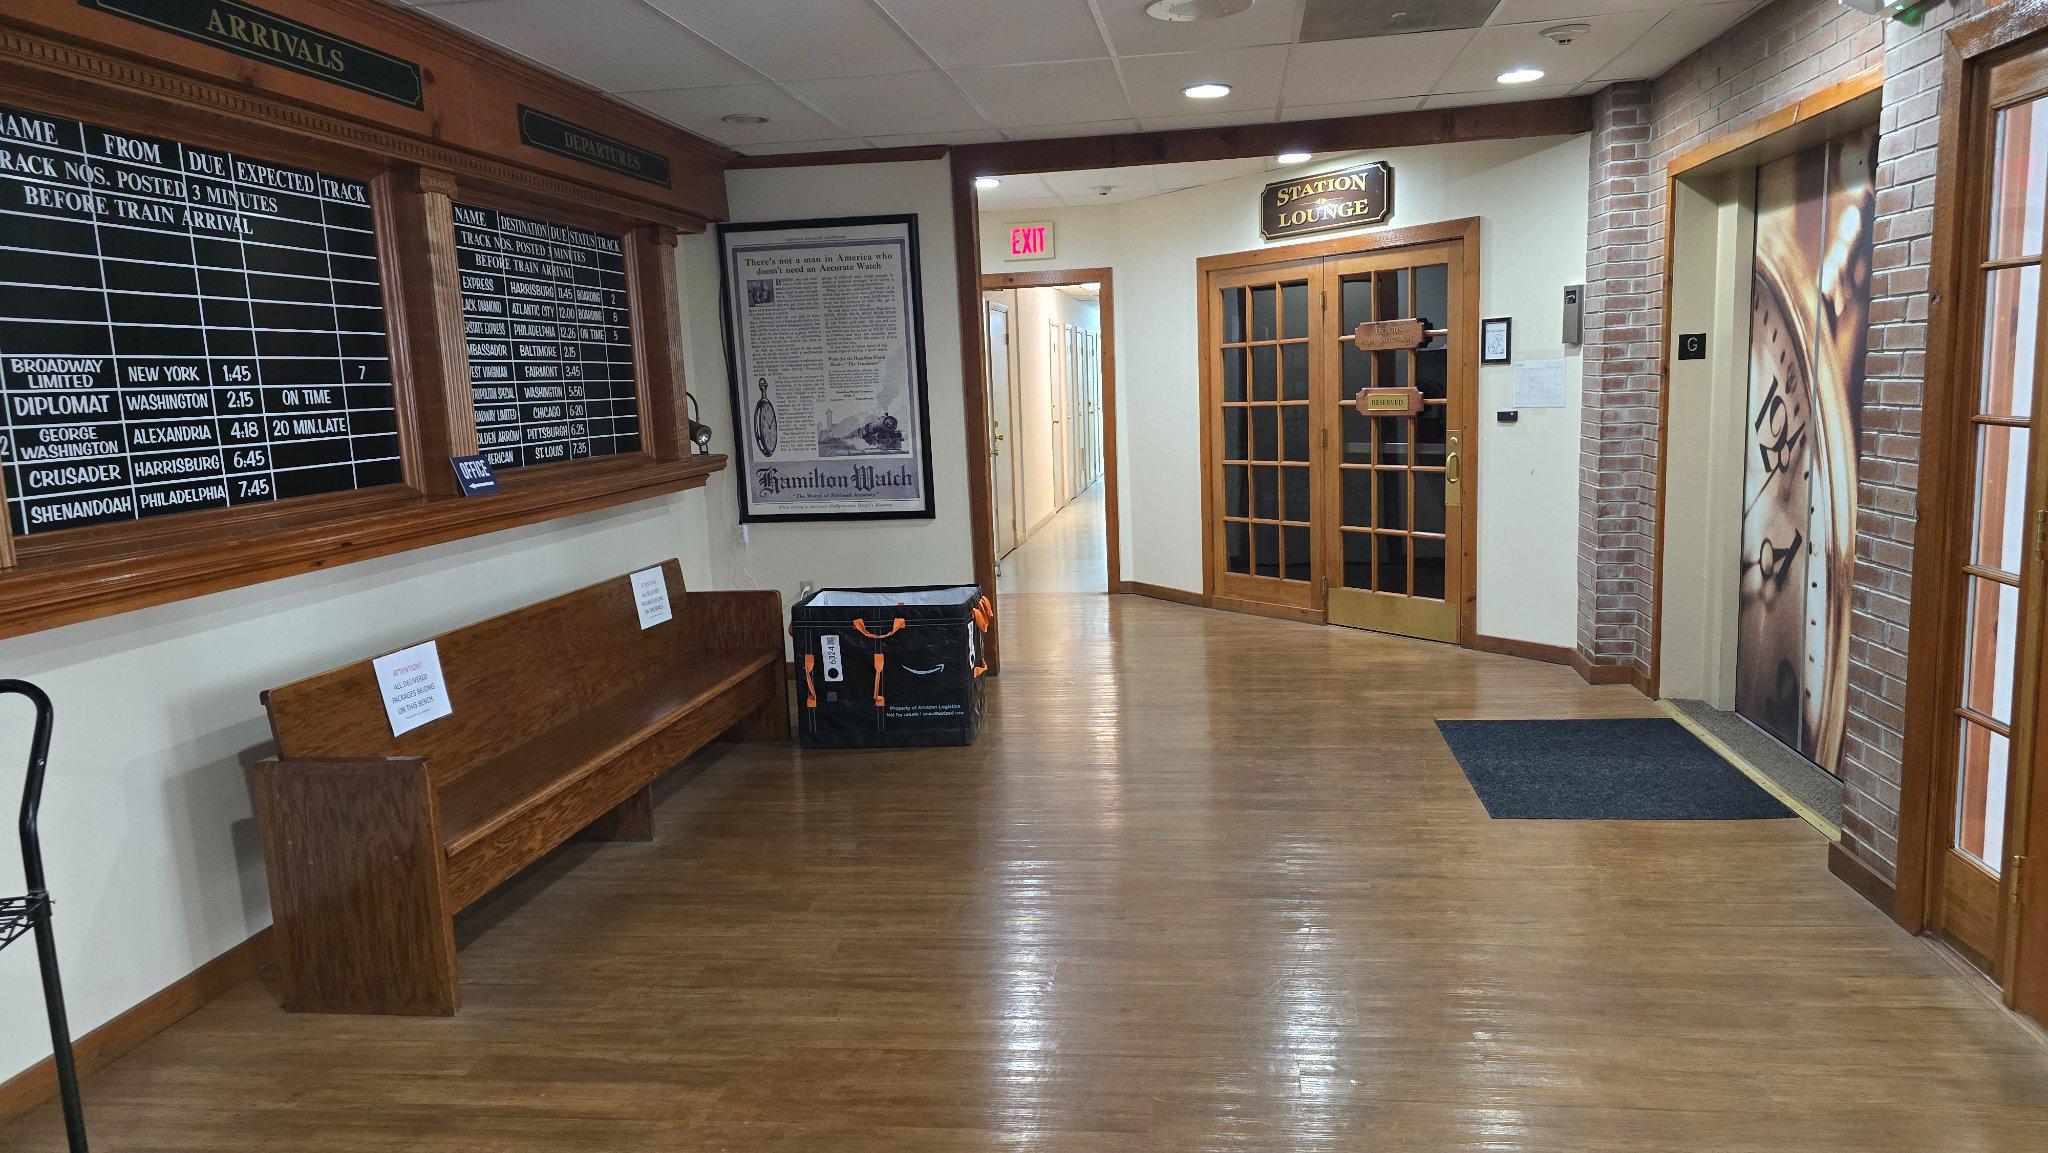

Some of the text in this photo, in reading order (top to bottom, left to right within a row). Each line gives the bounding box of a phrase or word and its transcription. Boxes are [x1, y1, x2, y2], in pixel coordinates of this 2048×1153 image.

[206, 8, 344, 72] ARRIVALS
[564, 131, 641, 170] DEPARTURES
[103, 133, 162, 164] FROM
[189, 151, 225, 176] DUE
[237, 161, 314, 193] EXPECTED
[322, 179, 366, 202] TRACK
[65, 161, 110, 186] NOS.
[117, 170, 187, 198] POSTED
[192, 184, 200, 200] 3
[207, 186, 278, 213] MINUTES
[1276, 172, 1368, 207] STATION
[24, 185, 253, 235] BEFORE TRAIN ARRIVAL
[1278, 199, 1369, 228] LOUNGE
[454, 206, 620, 252] NAME DESTINATION DUE STATUS TRACK
[461, 231, 491, 248] TRACK
[494, 237, 513, 251] NOS.
[516, 240, 546, 257] POSTED
[553, 247, 585, 262] MINUTES
[1011, 226, 1046, 255] EXIT
[475, 254, 573, 278] BEFORE TRAIN ARRIVAL
[745, 258, 776, 267] There's
[825, 254, 832, 262] in
[837, 252, 872, 262] America
[876, 252, 892, 260] who
[756, 267, 782, 275] doesn't
[786, 265, 803, 274] need
[820, 264, 854, 272] Accurate
[856, 262, 881, 270] Watch
[462, 275, 494, 292] EXPRESS
[510, 281, 555, 298] HARRISBURG
[611, 294, 615, 304] 2
[512, 302, 555, 317] ATLANTIC CITY
[613, 312, 617, 322] 8
[514, 324, 556, 338] PHILADELPHIA
[614, 331, 618, 340] 5
[520, 345, 557, 357] BALTIMORE
[1687, 337, 1698, 352] G
[11, 359, 103, 374] BROADWAY
[128, 365, 199, 382] NEW YORK
[223, 365, 251, 381] 1:45
[358, 366, 366, 380] 7
[525, 366, 558, 378] FAIRMONT
[28, 374, 94, 389] LIMITED
[14, 395, 110, 417] DIPLOMAT
[126, 393, 208, 411] WASHINGTON
[227, 391, 254, 408] 2:15
[282, 390, 332, 405] ON TIME
[533, 406, 560, 418] CHICAGO
[39, 426, 98, 441] GEORGE
[133, 425, 212, 444] ALEXANDRIA
[231, 421, 259, 438] 4:18
[273, 420, 289, 436] 20
[498, 430, 519, 442] ARROW
[527, 425, 568, 440] PITTSBURGH
[20, 440, 118, 461] WASHINGTON
[135, 457, 220, 477] HARRISBURG
[234, 450, 265, 469] 6:45
[29, 465, 121, 489] CRUSADER
[459, 460, 490, 480] OFFICE
[238, 478, 269, 498] 7:45
[756, 464, 912, 498] Hamilton Watch
[141, 485, 225, 509] PHILADELPHIA
[31, 496, 131, 524] SHENANDOAH
[827, 646, 837, 665] 6324
[402, 673, 428, 687] DELIVERED
[392, 683, 435, 704] PACKAGES BELONG
[397, 707, 406, 715] ON
[406, 701, 418, 711] THIS
[417, 696, 434, 707] BENCH
